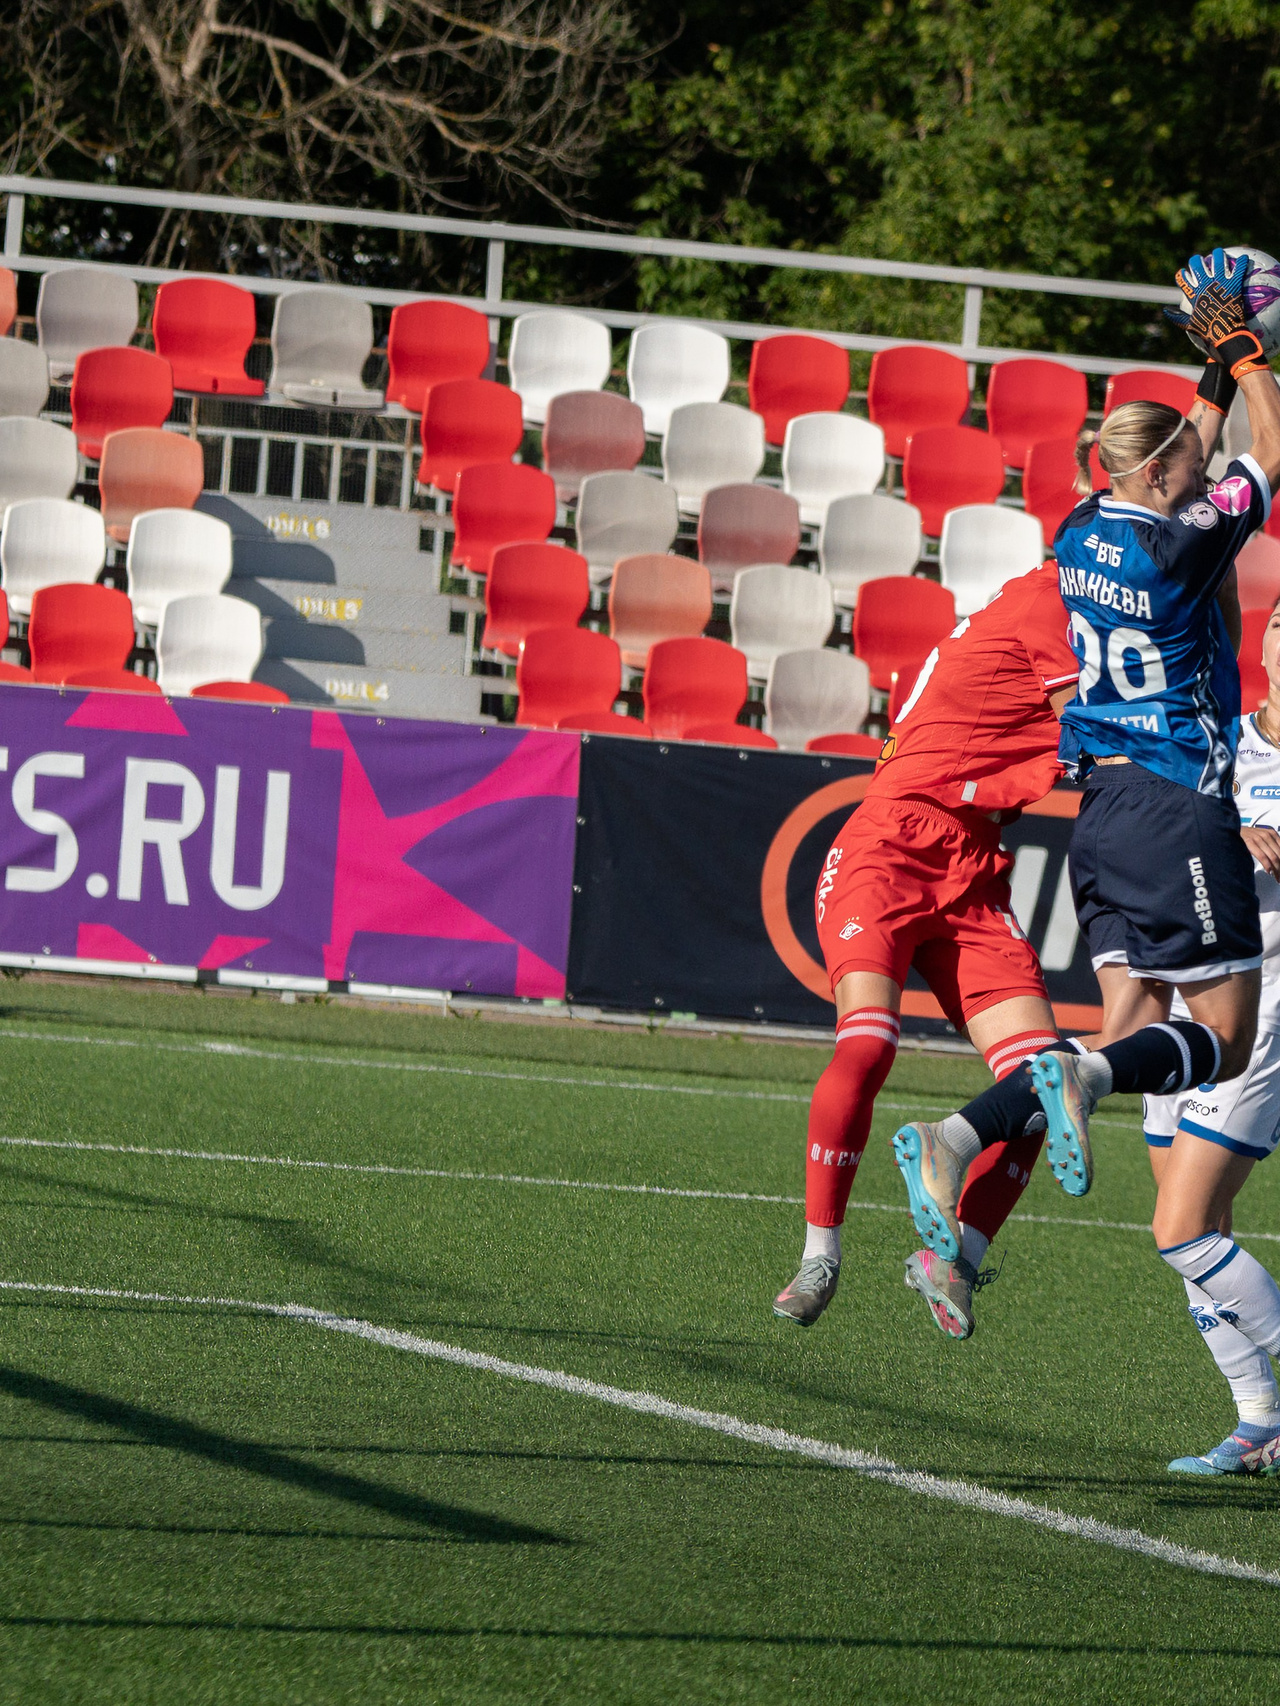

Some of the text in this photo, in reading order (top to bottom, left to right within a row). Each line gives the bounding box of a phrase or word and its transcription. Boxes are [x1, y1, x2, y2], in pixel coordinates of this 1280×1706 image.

[1096, 542, 1124, 568] ВТБ
[0, 746, 291, 911] S.RU
[1188, 856, 1218, 945] BetBoom
